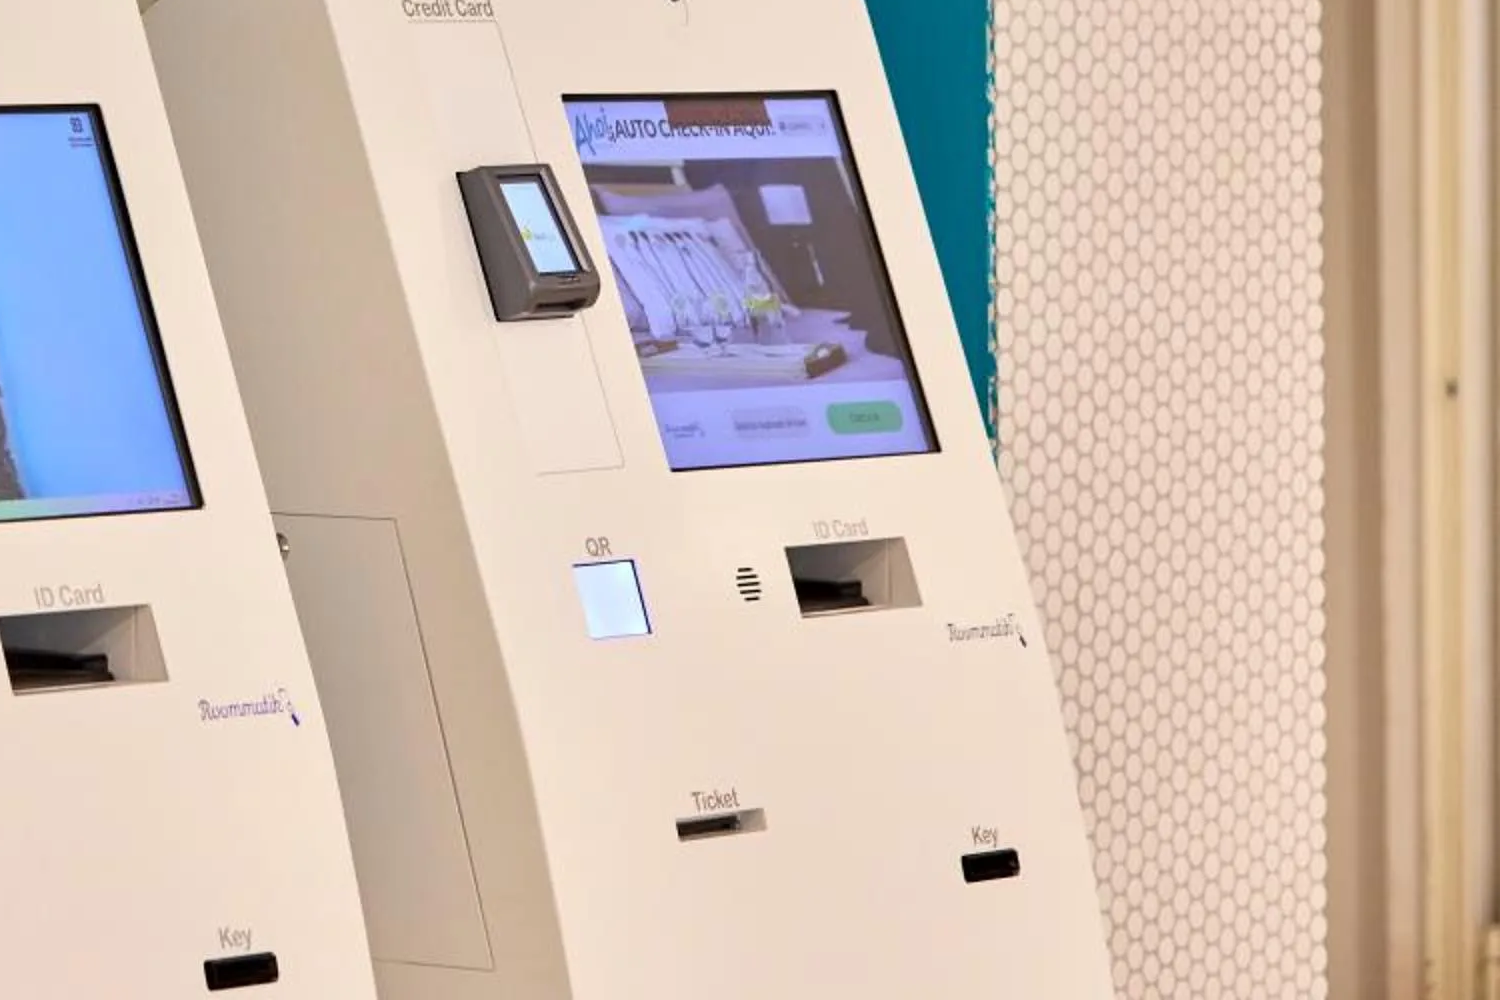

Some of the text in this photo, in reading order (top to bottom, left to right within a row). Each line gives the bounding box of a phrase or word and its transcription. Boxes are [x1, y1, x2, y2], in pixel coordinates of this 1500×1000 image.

[811, 516, 869, 540] ID Card
[585, 536, 613, 557] QR
[33, 583, 105, 609] ID Card
[690, 787, 741, 812] Ticket
[971, 825, 998, 849] Key
[218, 925, 252, 951] Key
